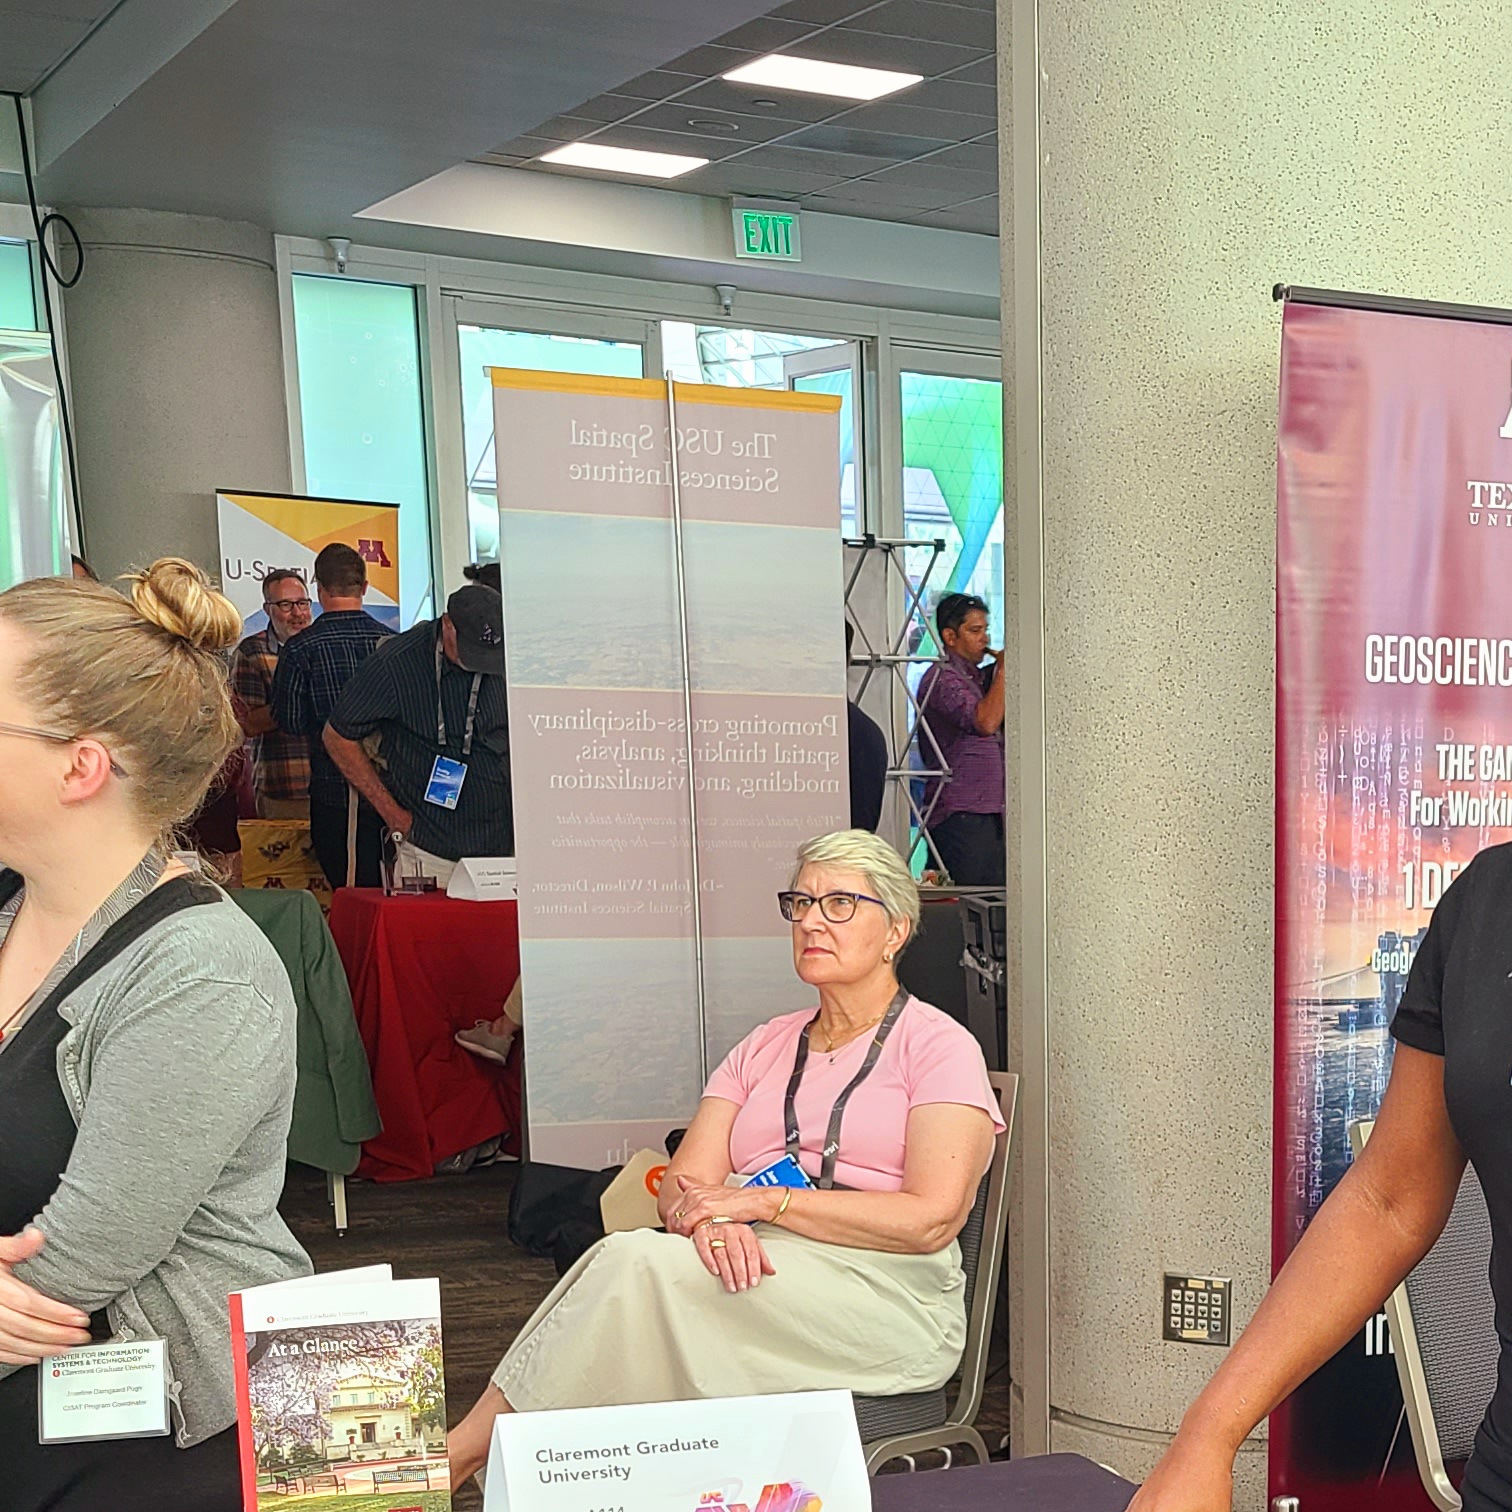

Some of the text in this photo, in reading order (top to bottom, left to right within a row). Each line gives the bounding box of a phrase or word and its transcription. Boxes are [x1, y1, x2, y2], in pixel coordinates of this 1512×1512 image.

[743, 213, 793, 255] EXIT
[1436, 744, 1475, 782] THE
[1410, 790, 1444, 826] For
[1402, 861, 1468, 910] 1 DE
[52, 1347, 150, 1362] CENTER FOR INFORMATION
[268, 1338, 359, 1358] At a Glance
[52, 1360, 84, 1369] SYSTEMS
[93, 1355, 143, 1366] TECHNOLOGY
[61, 1362, 155, 1377] Claremont Graduate University
[535, 1437, 720, 1465] Claremont Graduate
[538, 1463, 633, 1485] University
